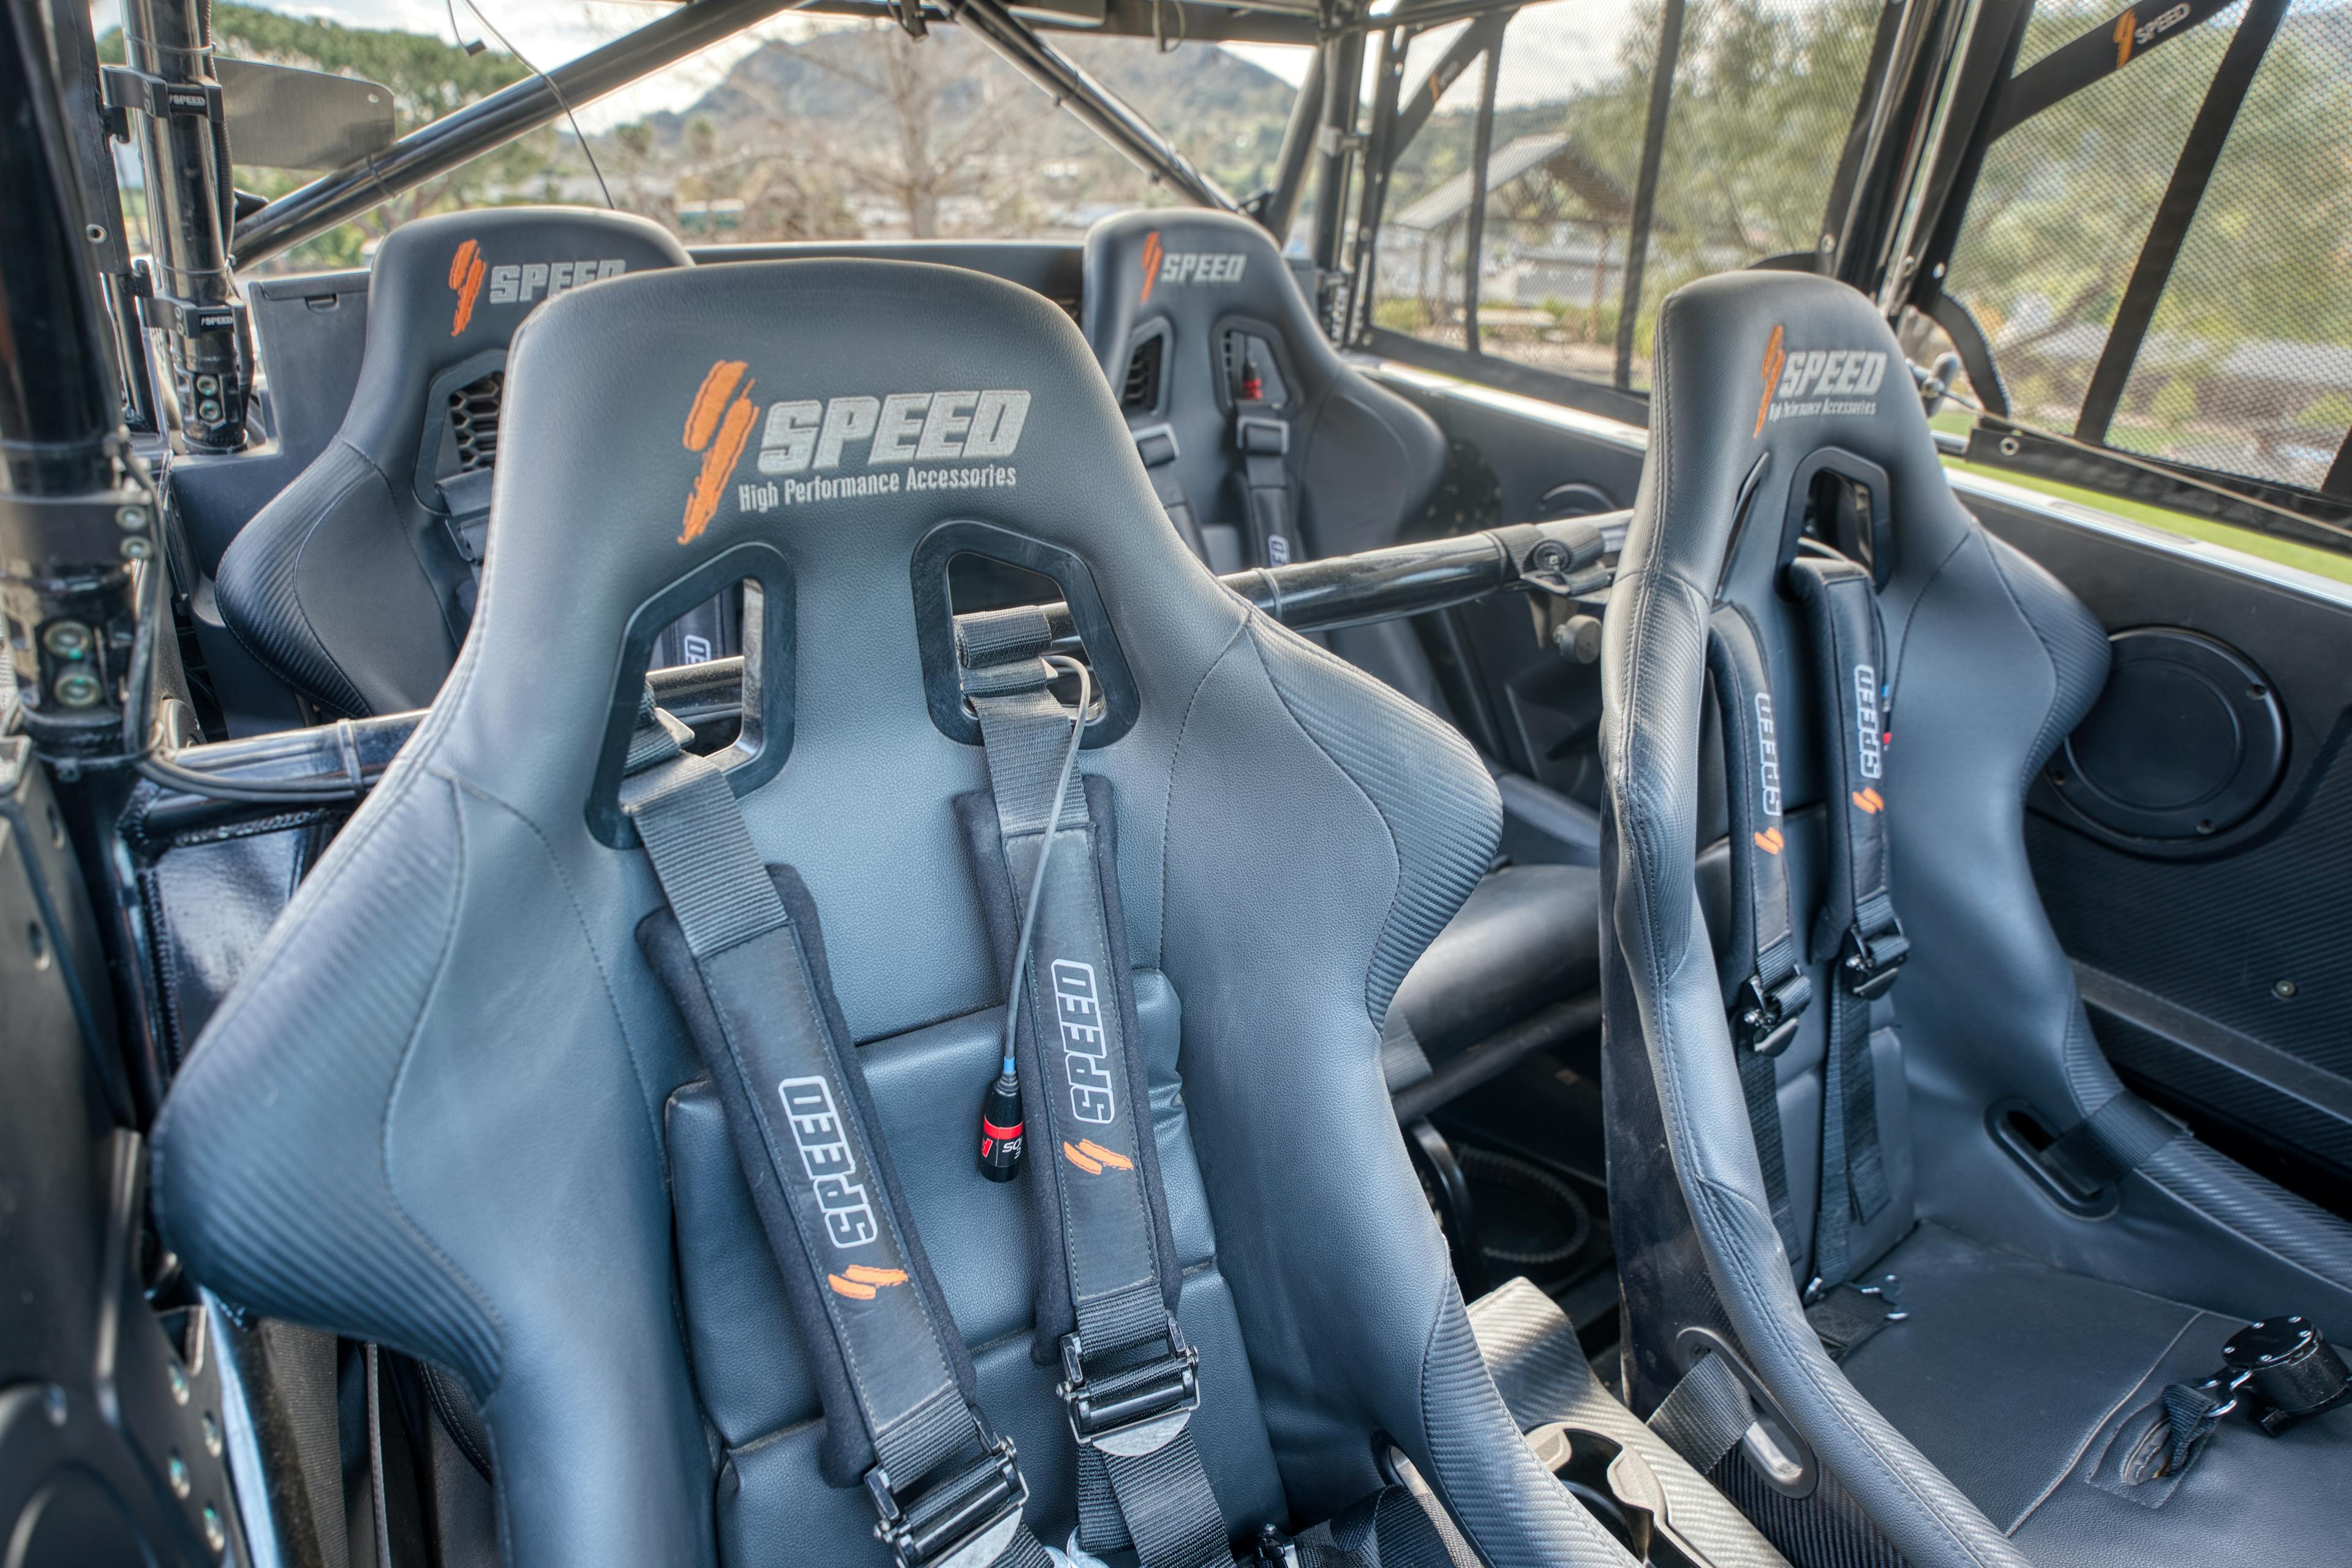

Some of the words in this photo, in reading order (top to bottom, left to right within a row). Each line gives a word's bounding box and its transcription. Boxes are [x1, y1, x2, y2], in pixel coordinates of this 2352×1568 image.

[2134, 2, 2191, 45] SPEED
[173, 94, 206, 107] SPEED
[1161, 253, 1248, 283] SPEED
[205, 316, 233, 326] SPEED
[1778, 350, 1888, 398] SPEED
[1821, 398, 1878, 416] Accessories
[757, 390, 1032, 475] SPEED
[739, 481, 778, 513] High
[785, 472, 900, 505] Performance
[905, 464, 1017, 491] Accessories
[1854, 664, 1883, 779] SPEED
[1755, 692, 1783, 816] SPEED
[1050, 959, 1115, 1124] SPEED
[778, 1076, 878, 1249] SPEED
